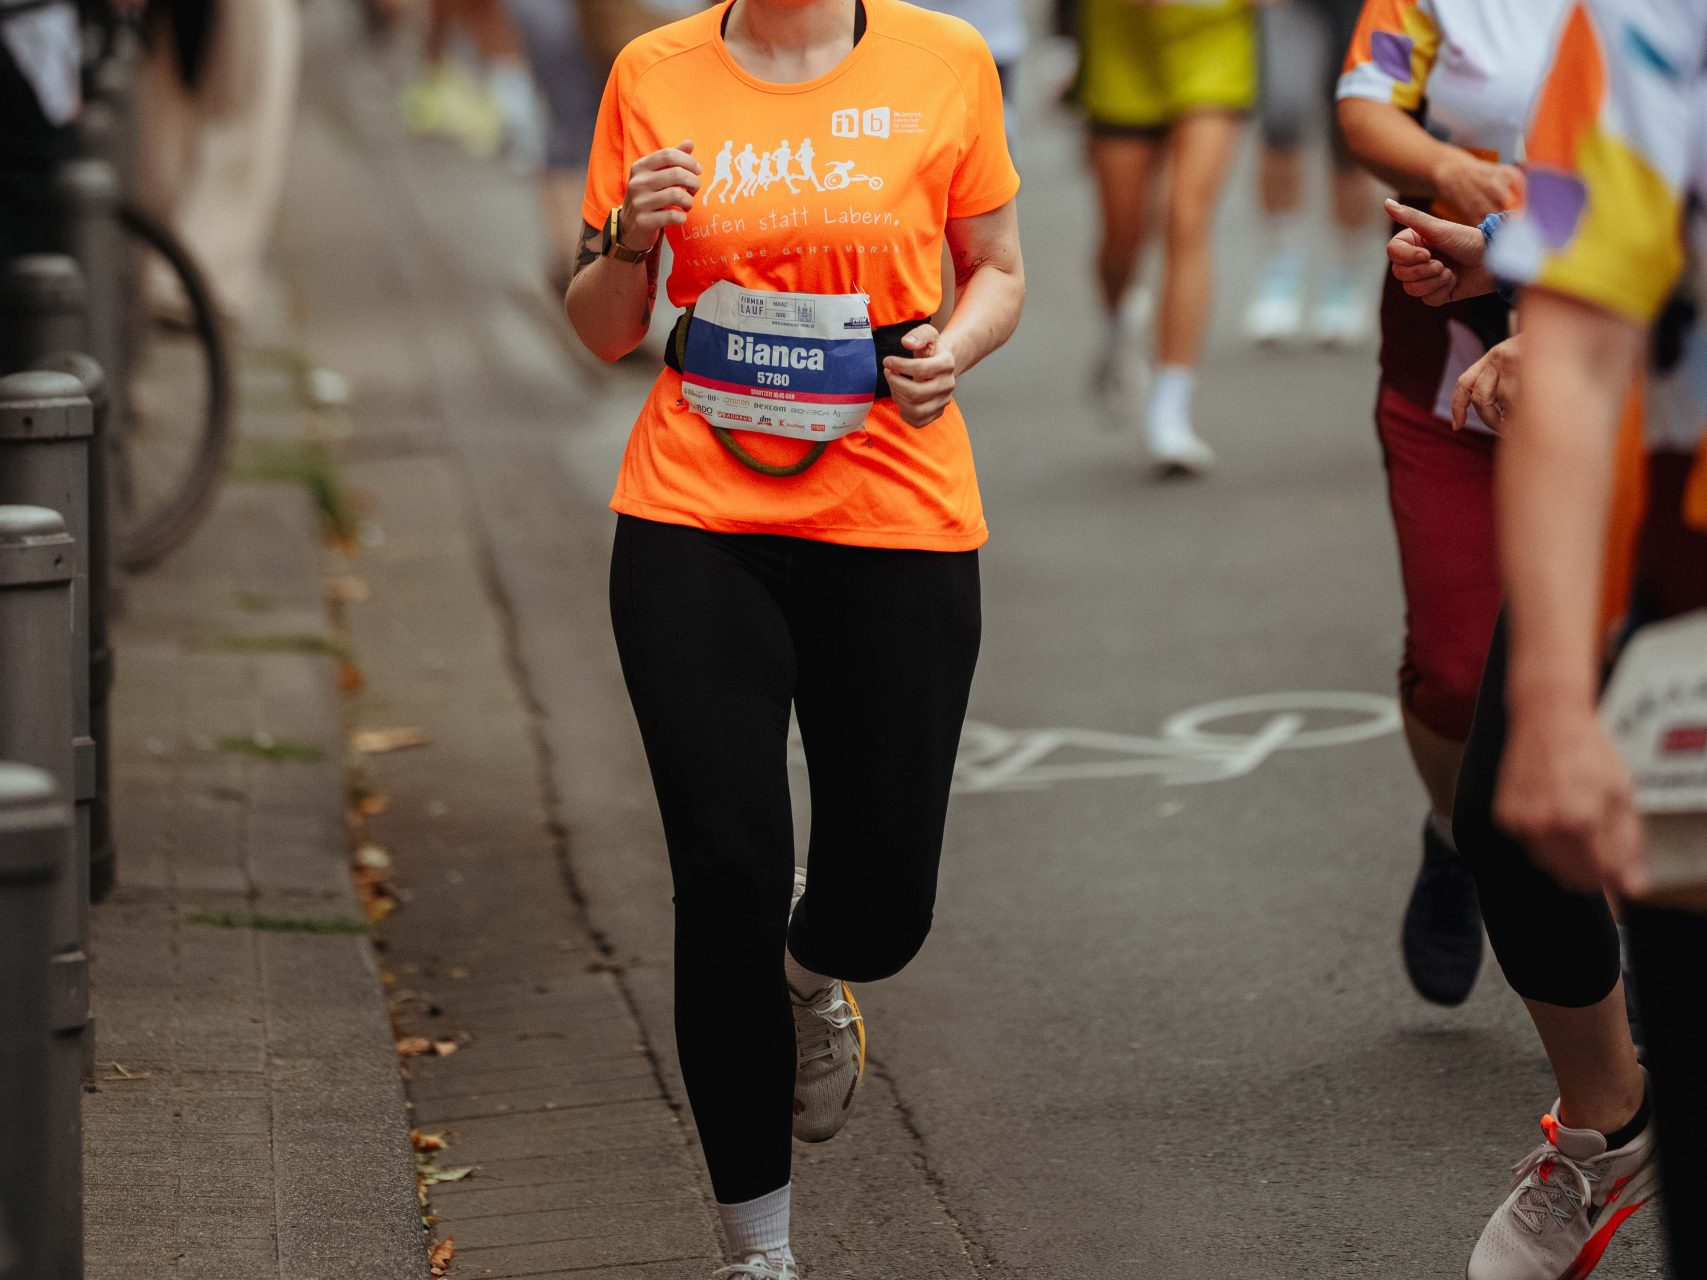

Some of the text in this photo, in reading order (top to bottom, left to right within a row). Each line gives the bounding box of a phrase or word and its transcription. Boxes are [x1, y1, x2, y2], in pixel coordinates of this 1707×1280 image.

[682, 206, 900, 241] Laufen statt Labern.
[686, 249, 767, 267] TEILHABE
[782, 245, 830, 255] GEHT
[741, 296, 765, 306] FIRMEN
[741, 304, 765, 316] LAUF
[727, 333, 824, 370] Bianca
[757, 371, 790, 387] 5780
[759, 415, 772, 423] dm
